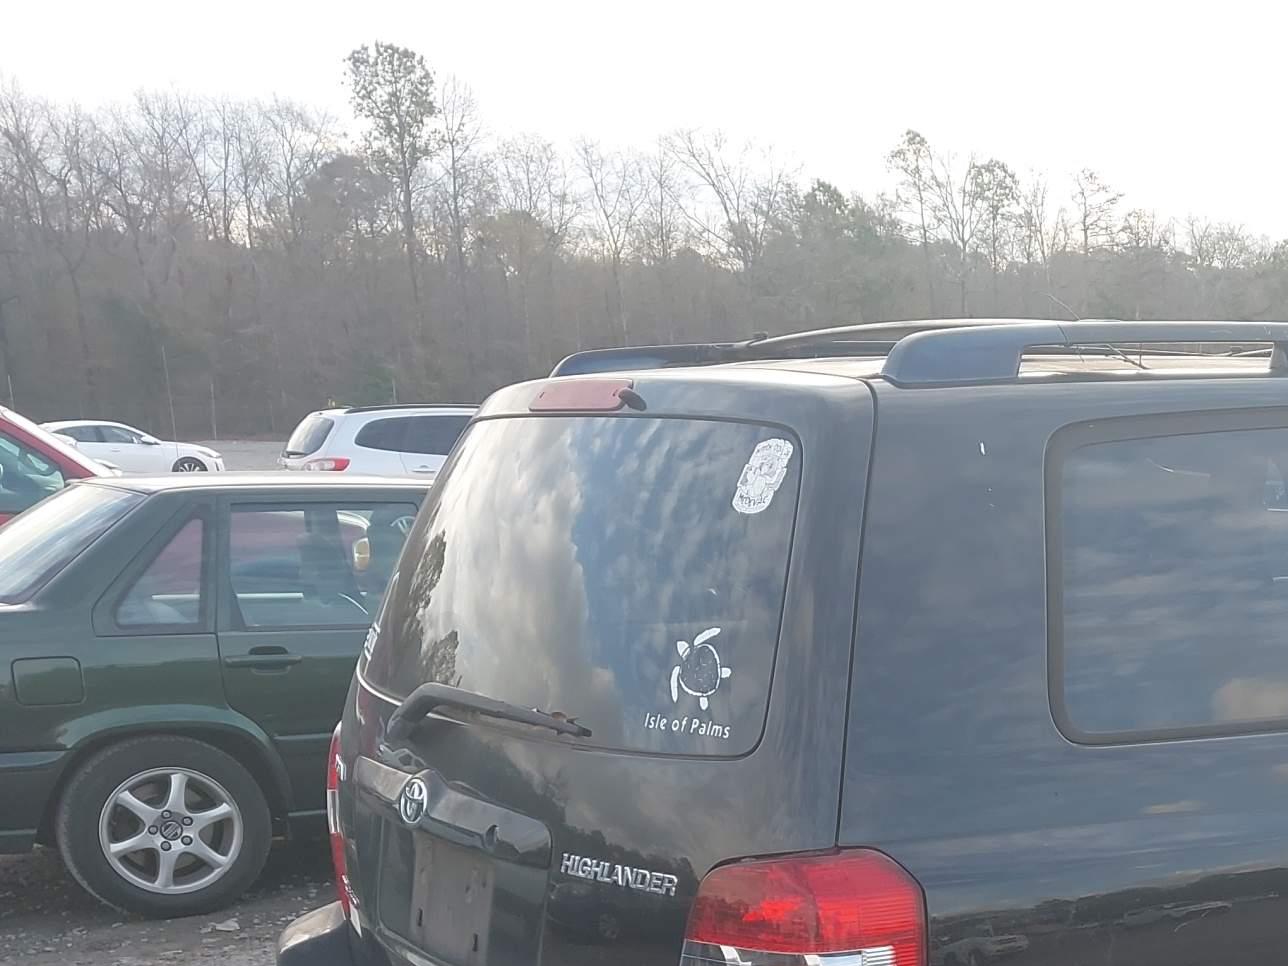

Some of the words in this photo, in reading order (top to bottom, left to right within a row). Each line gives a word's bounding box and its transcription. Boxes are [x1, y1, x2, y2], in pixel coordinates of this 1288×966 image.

[644, 712, 667, 730] Isle
[671, 716, 688, 732] of
[690, 718, 731, 738] Palms
[560, 852, 678, 897] HIGHLANDER
